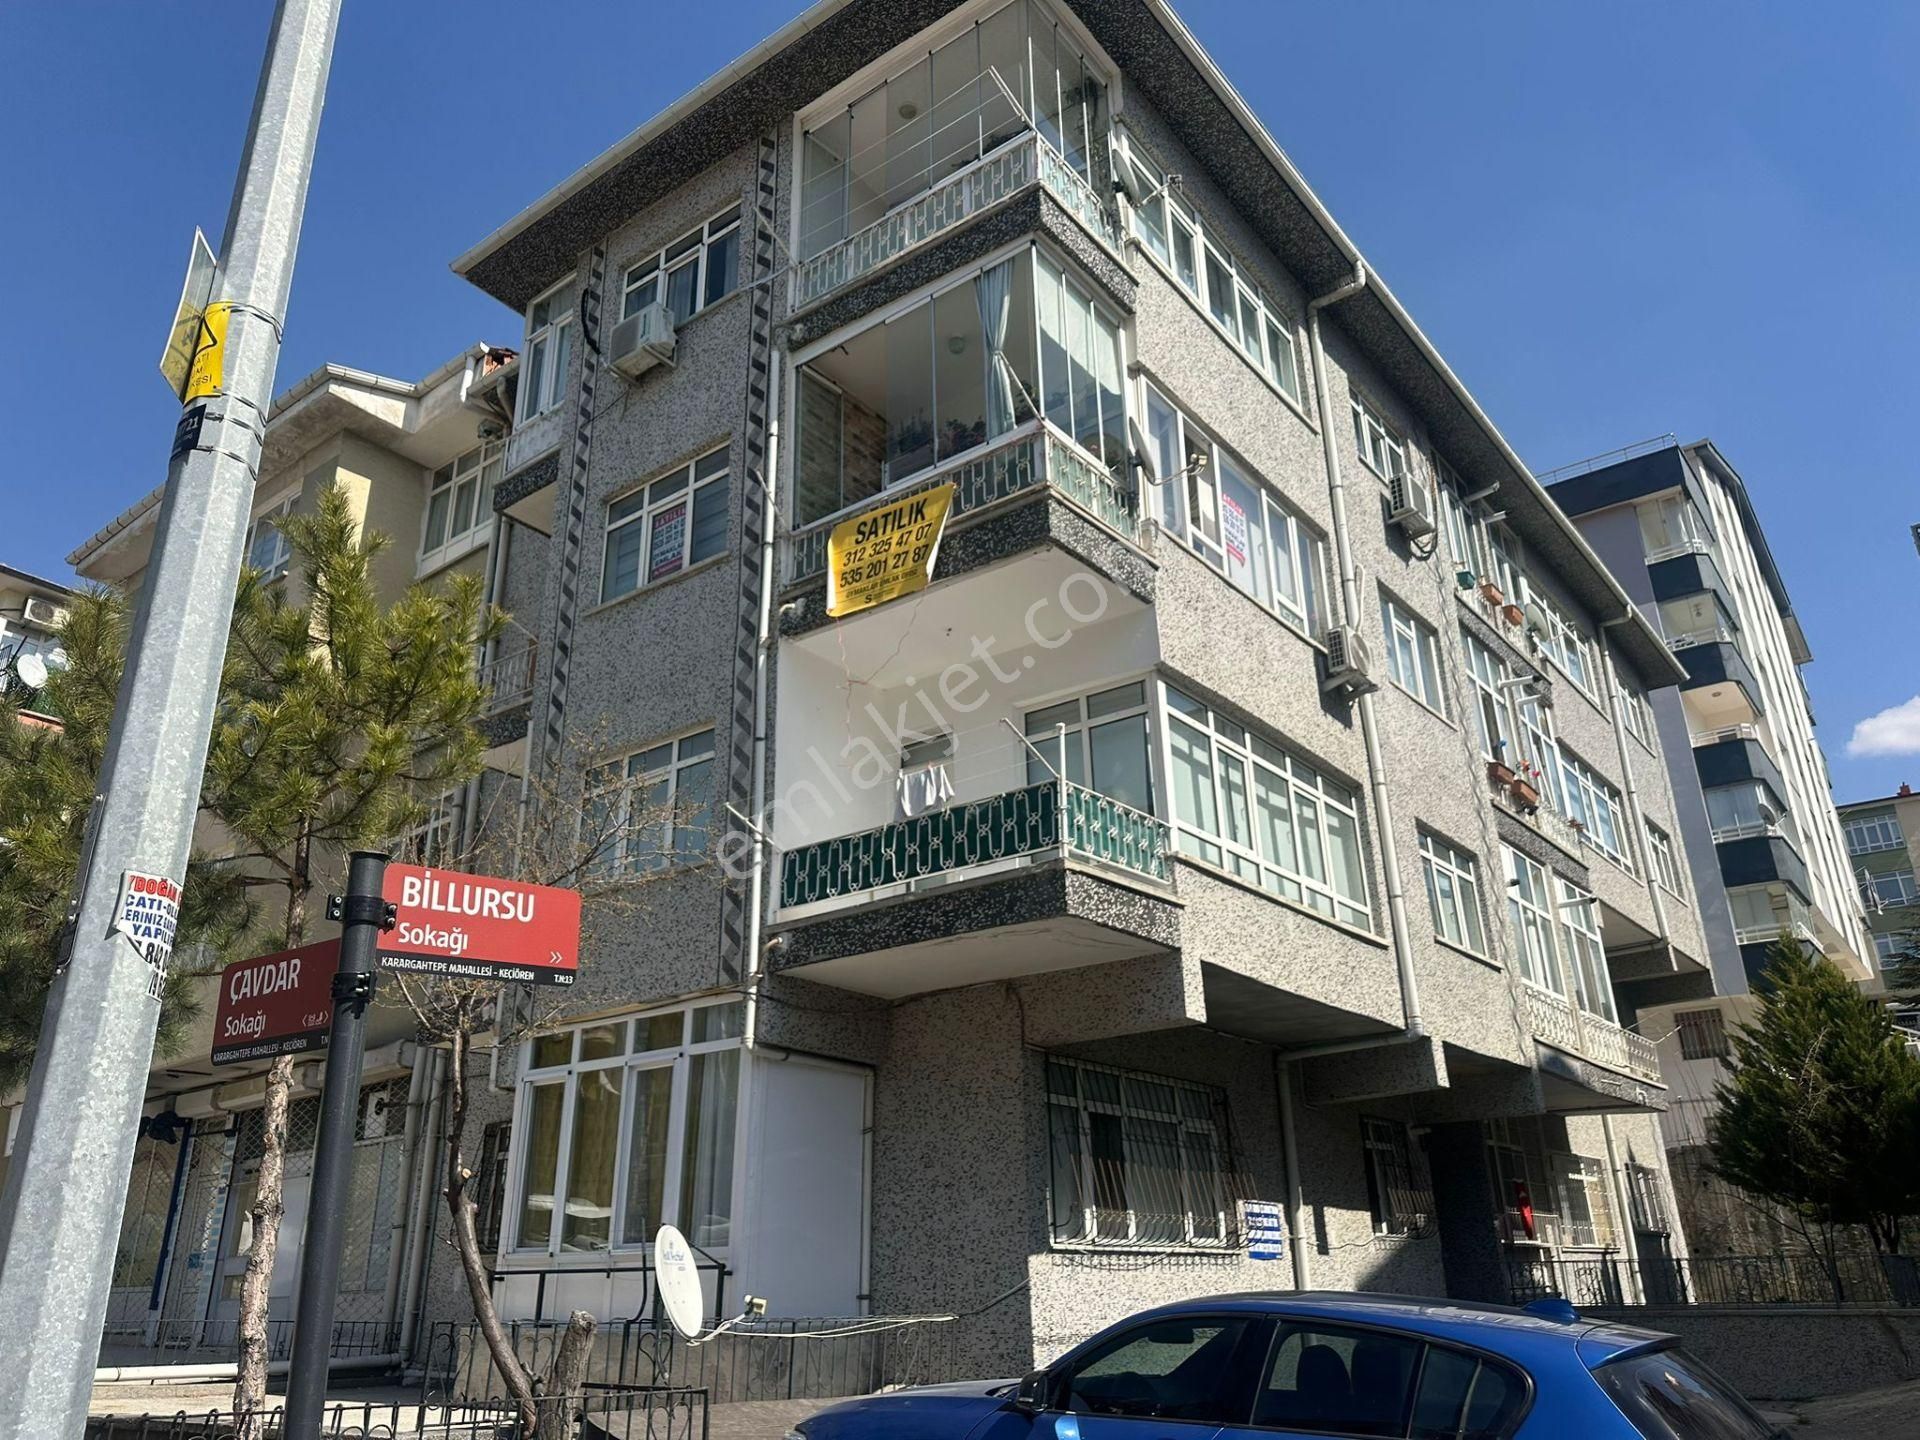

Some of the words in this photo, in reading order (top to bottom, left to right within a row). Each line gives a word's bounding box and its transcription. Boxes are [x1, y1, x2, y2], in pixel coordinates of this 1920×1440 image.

[855, 498, 928, 545] SATILIK
[840, 564, 863, 588] 535
[866, 557, 888, 580] 201
[892, 550, 909, 570] 27
[912, 544, 930, 563] 87
[843, 546, 866, 567] 312
[869, 536, 892, 558] 325
[896, 530, 912, 547] 47
[915, 522, 933, 541] 07
[401, 870, 535, 922] BİLLURSU
[398, 921, 468, 955] Sokağı
[230, 958, 301, 1005] ÇAVDAR
[381, 956, 447, 973] KARARGAHTEPE
[449, 963, 493, 977] MAHALLESİ
[499, 968, 535, 981] KEÇİÖREN
[224, 1009, 267, 1038] Sokağı
[213, 1048, 251, 1062] KARARGAHTEPE
